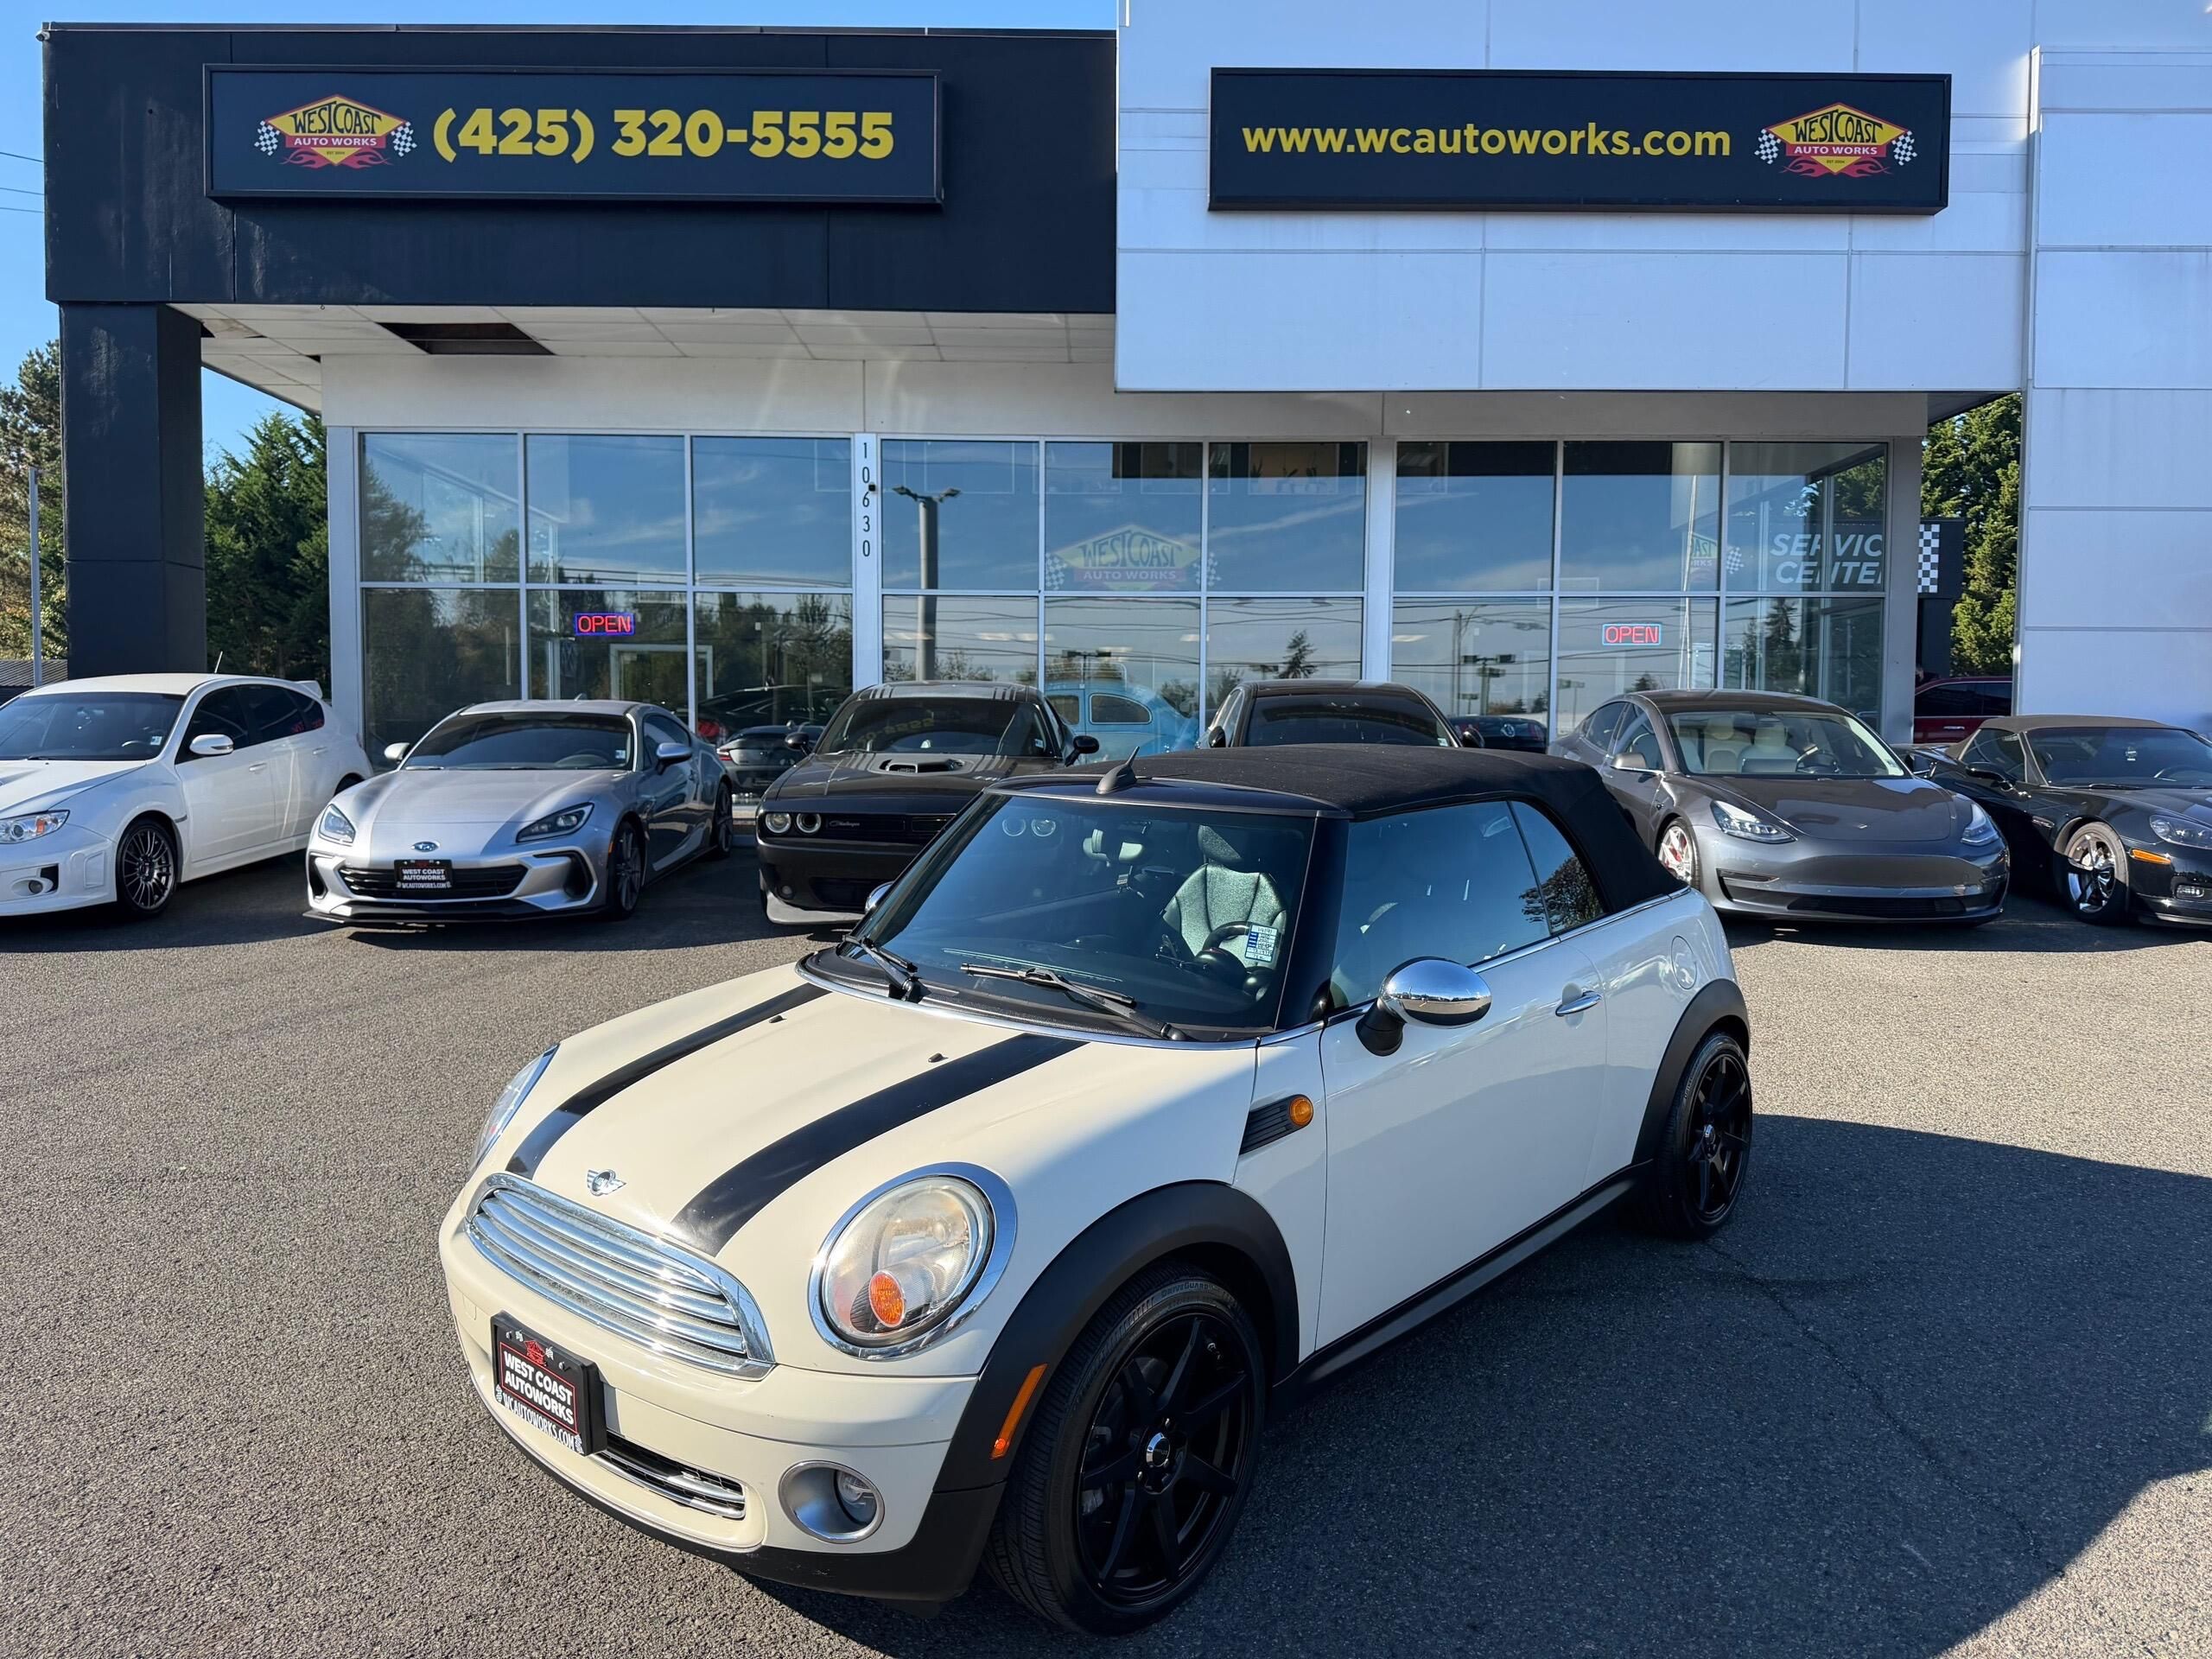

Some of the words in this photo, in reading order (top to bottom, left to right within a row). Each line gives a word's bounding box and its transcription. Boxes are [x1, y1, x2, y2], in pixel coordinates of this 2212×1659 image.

[294, 137, 328, 146] AUTO
[332, 137, 377, 146] WORKS
[433, 107, 594, 164] (425)
[611, 108, 894, 160] 320-5555
[1242, 122, 1731, 156] www.wcautoworks.com
[1794, 146, 1829, 155] AUTO
[1832, 146, 1878, 155] WORKS
[1770, 534, 1883, 556] SEVIC
[1084, 570, 1122, 581] AUTO
[1126, 570, 1177, 581] WORKS
[1776, 561, 1882, 584] CETE
[578, 615, 631, 632] OPEN
[1605, 626, 1658, 643] OPEN
[504, 1351, 534, 1382] WEST
[536, 1370, 573, 1406] COAST
[505, 1370, 575, 1426] AUTOWORKS
[503, 1392, 575, 1451] WCAUTOWORKS.COM
